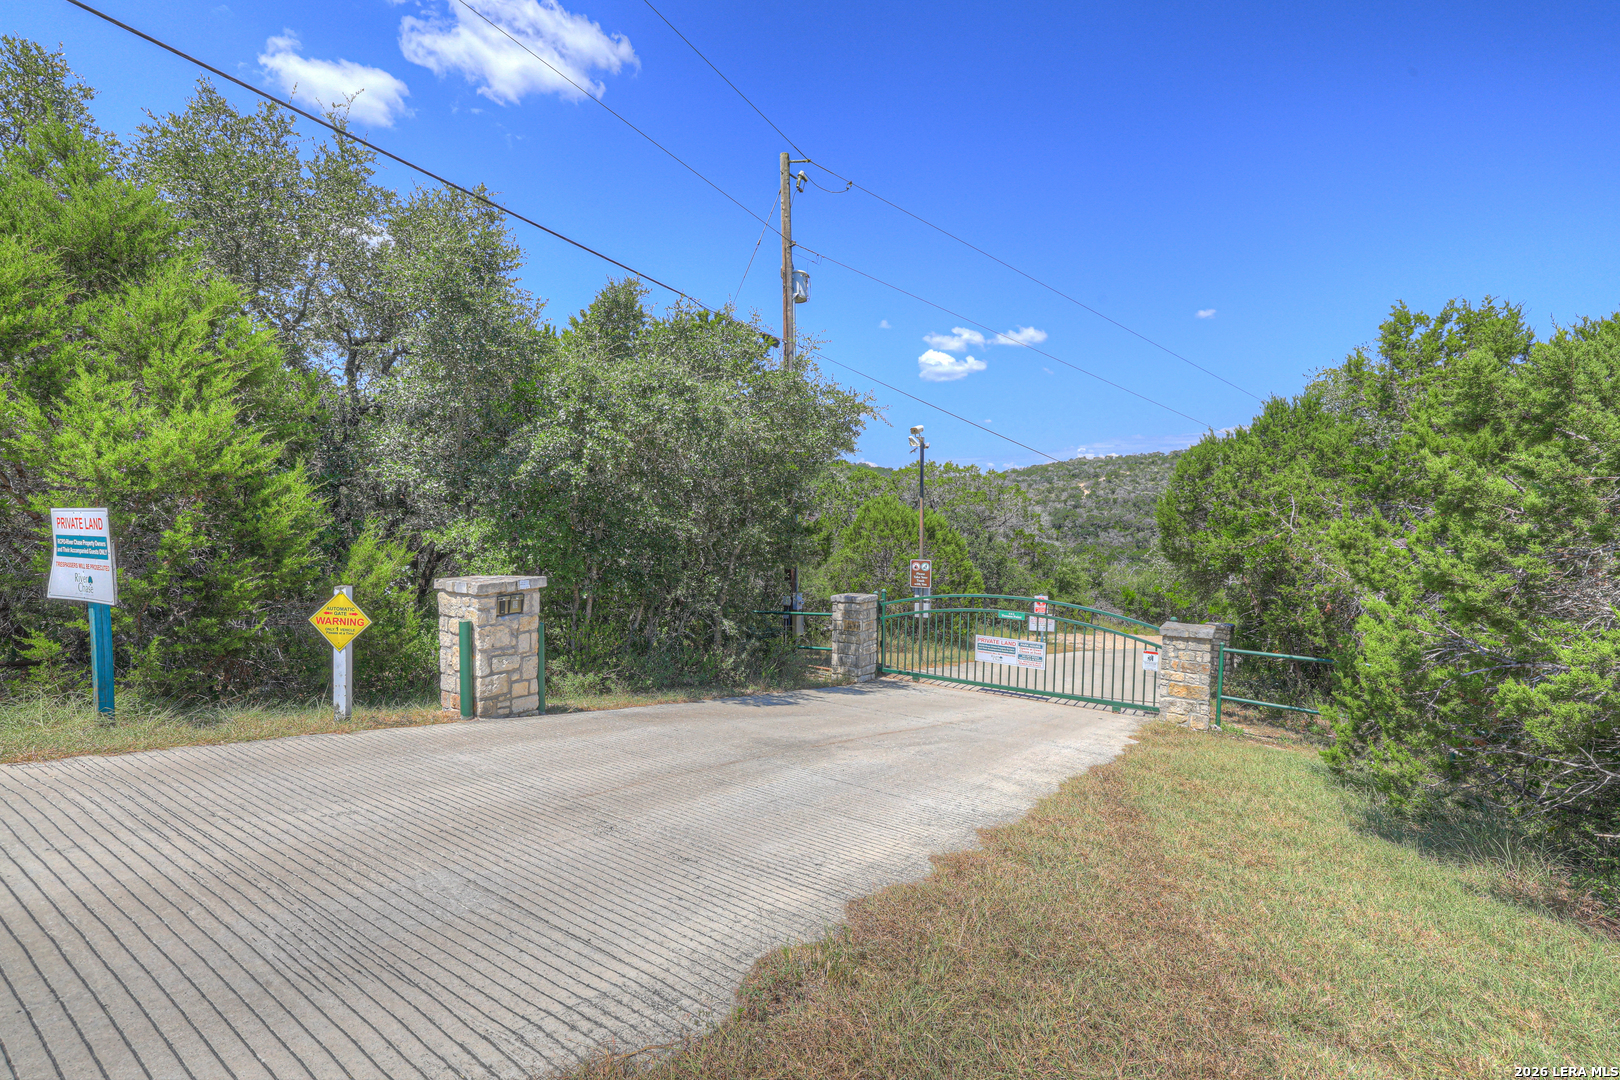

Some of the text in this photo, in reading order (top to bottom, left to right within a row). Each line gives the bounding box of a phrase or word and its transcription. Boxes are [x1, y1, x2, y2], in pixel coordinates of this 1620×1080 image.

[56, 517, 103, 530] PRIVATE LAND
[82, 539, 95, 548] Property
[75, 572, 88, 583] River
[78, 582, 94, 594] Chase
[316, 616, 364, 627] WARNING
